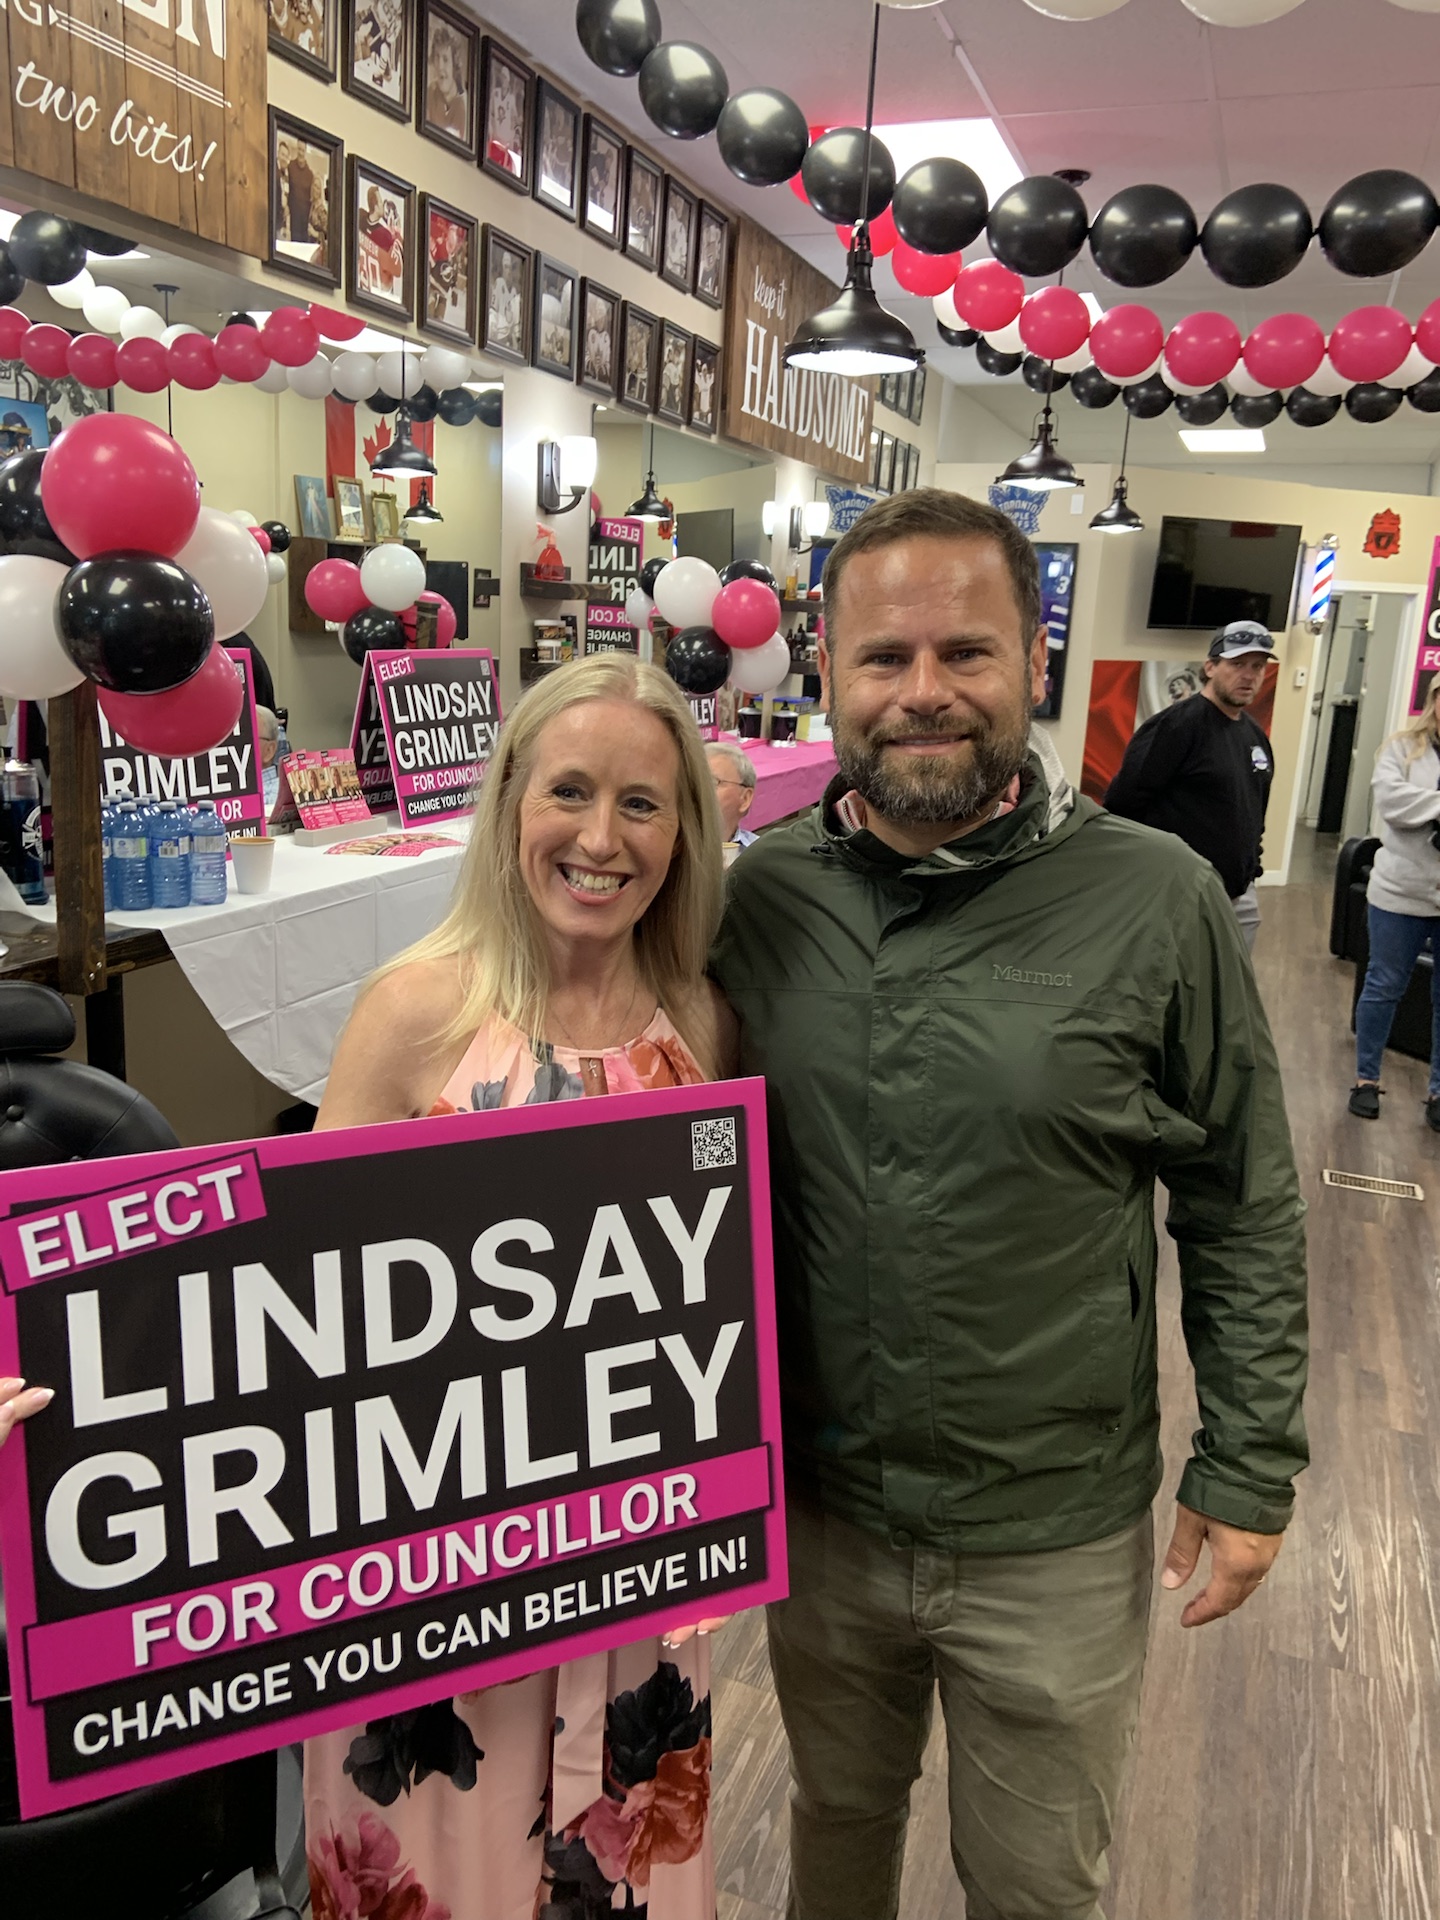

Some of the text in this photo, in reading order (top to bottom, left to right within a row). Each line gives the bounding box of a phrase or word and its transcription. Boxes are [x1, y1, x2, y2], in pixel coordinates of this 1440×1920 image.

[15, 61, 217, 182] two bits!
[754, 265, 788, 320] keep it
[740, 319, 869, 463] HANDSOME
[379, 657, 413, 681] ELECT
[389, 680, 491, 725] LINDSAY
[100, 744, 252, 802] RIMLEY
[395, 721, 500, 770] GRIMLEY
[408, 796, 441, 816] CHANGE
[440, 793, 457, 809] YOU
[412, 773, 436, 793] FOR
[992, 964, 1073, 987] Marmot
[18, 1165, 242, 1278] ELECT
[66, 1186, 732, 1428] LINDSAY
[45, 1321, 744, 1590] GRIMLEY
[131, 1472, 699, 1667] FOR COUNCILLOR
[73, 1536, 748, 1756] CHANGE YOU CAN BELIEVE IN!
